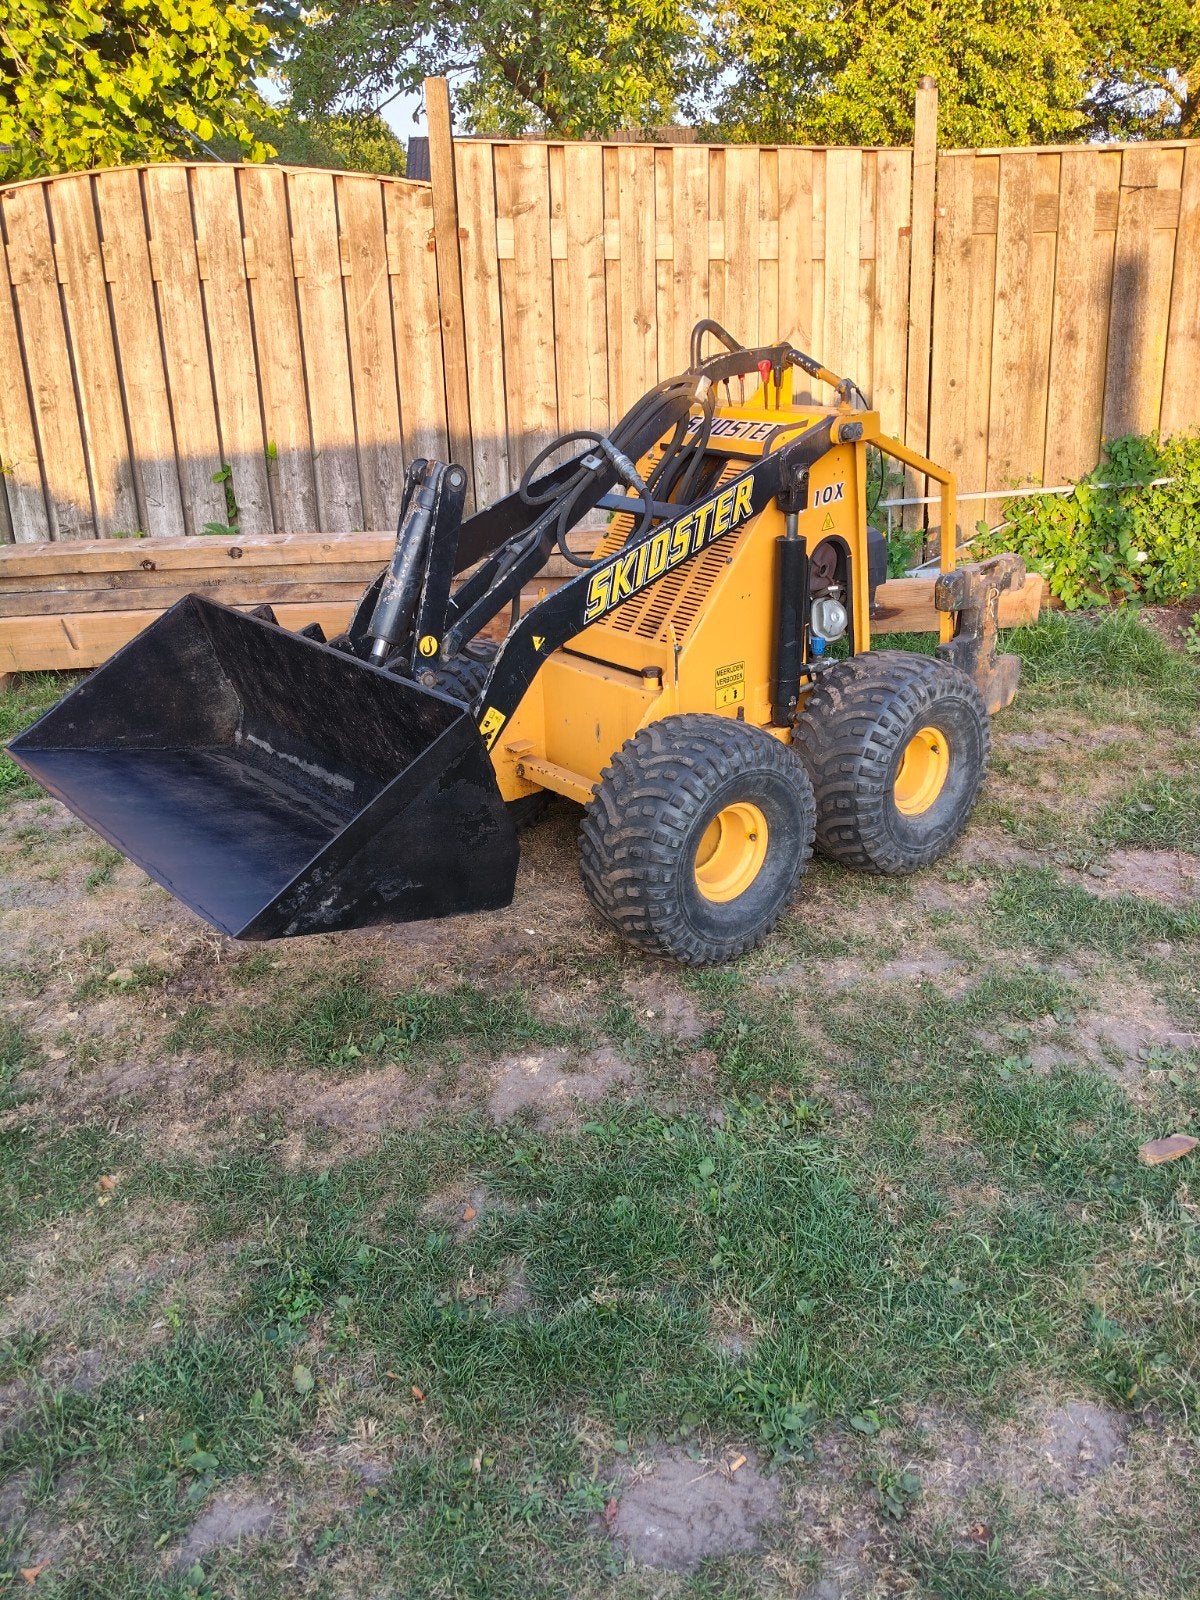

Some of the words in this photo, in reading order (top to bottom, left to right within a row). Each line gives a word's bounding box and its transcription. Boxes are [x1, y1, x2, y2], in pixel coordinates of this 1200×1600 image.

[814, 482, 844, 507] 10X
[584, 475, 755, 624] SKIDSTER
[716, 672, 743, 686] VERBODEN
